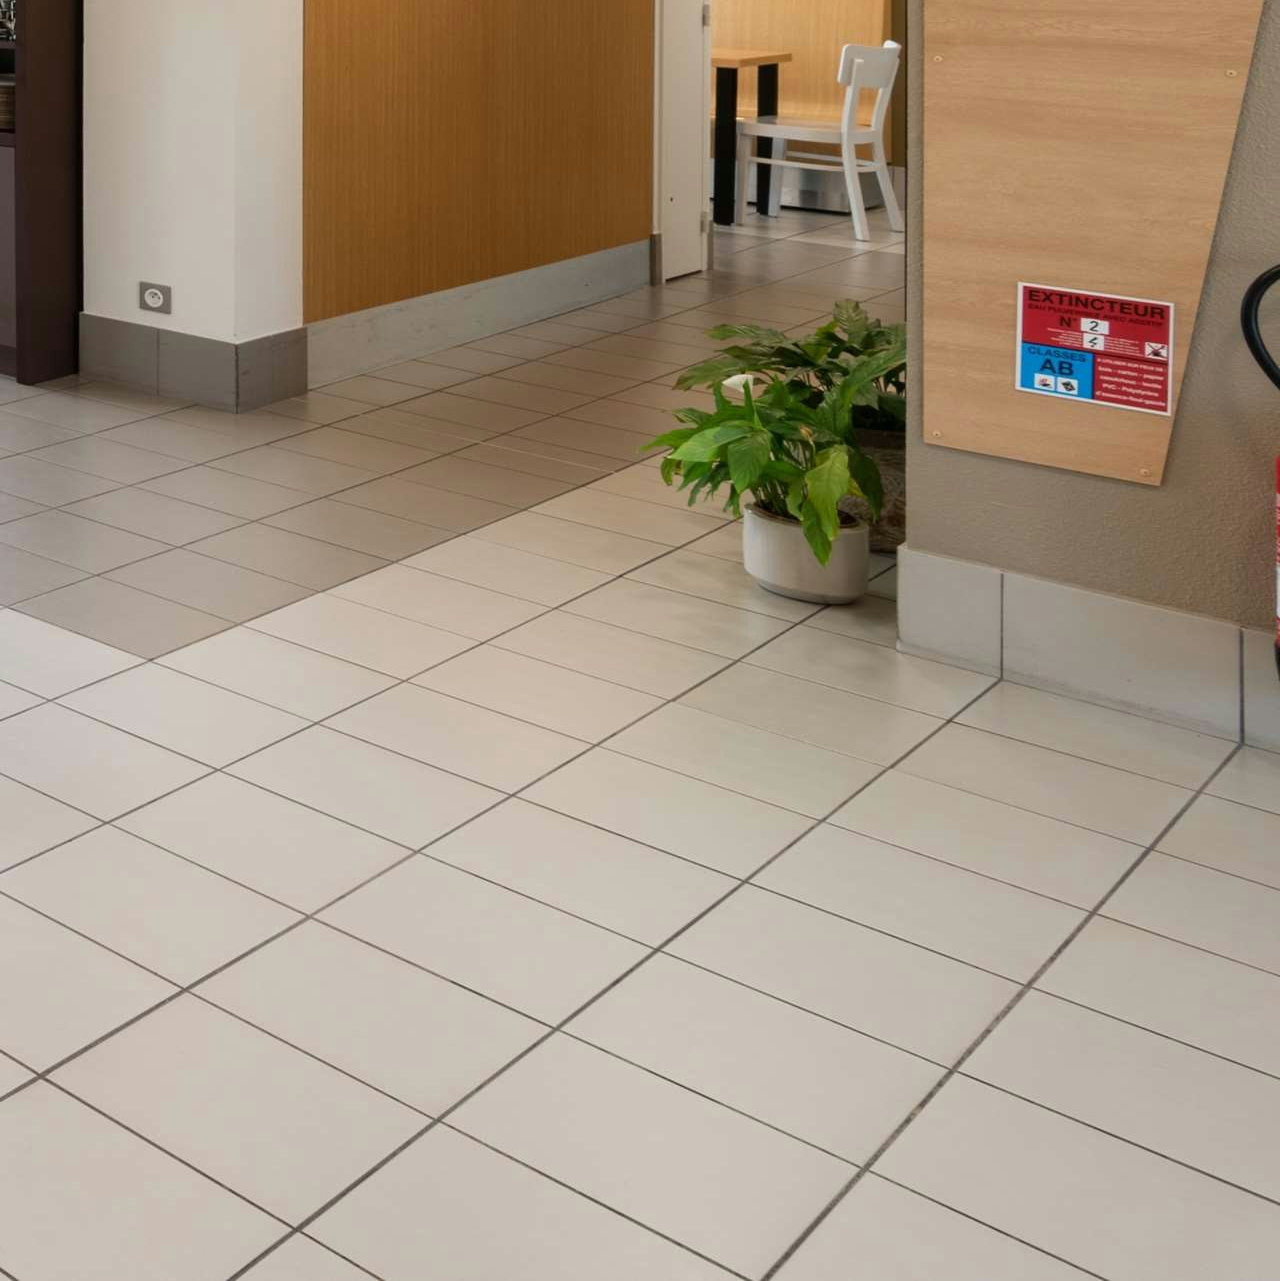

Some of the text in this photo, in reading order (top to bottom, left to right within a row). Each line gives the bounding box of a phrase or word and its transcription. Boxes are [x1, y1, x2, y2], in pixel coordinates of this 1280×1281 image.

[1028, 289, 1165, 319] EXTINCTEUR
[1089, 320, 1099, 332] 2
[1027, 346, 1087, 363] CLASSES
[1040, 358, 1074, 376] AB
